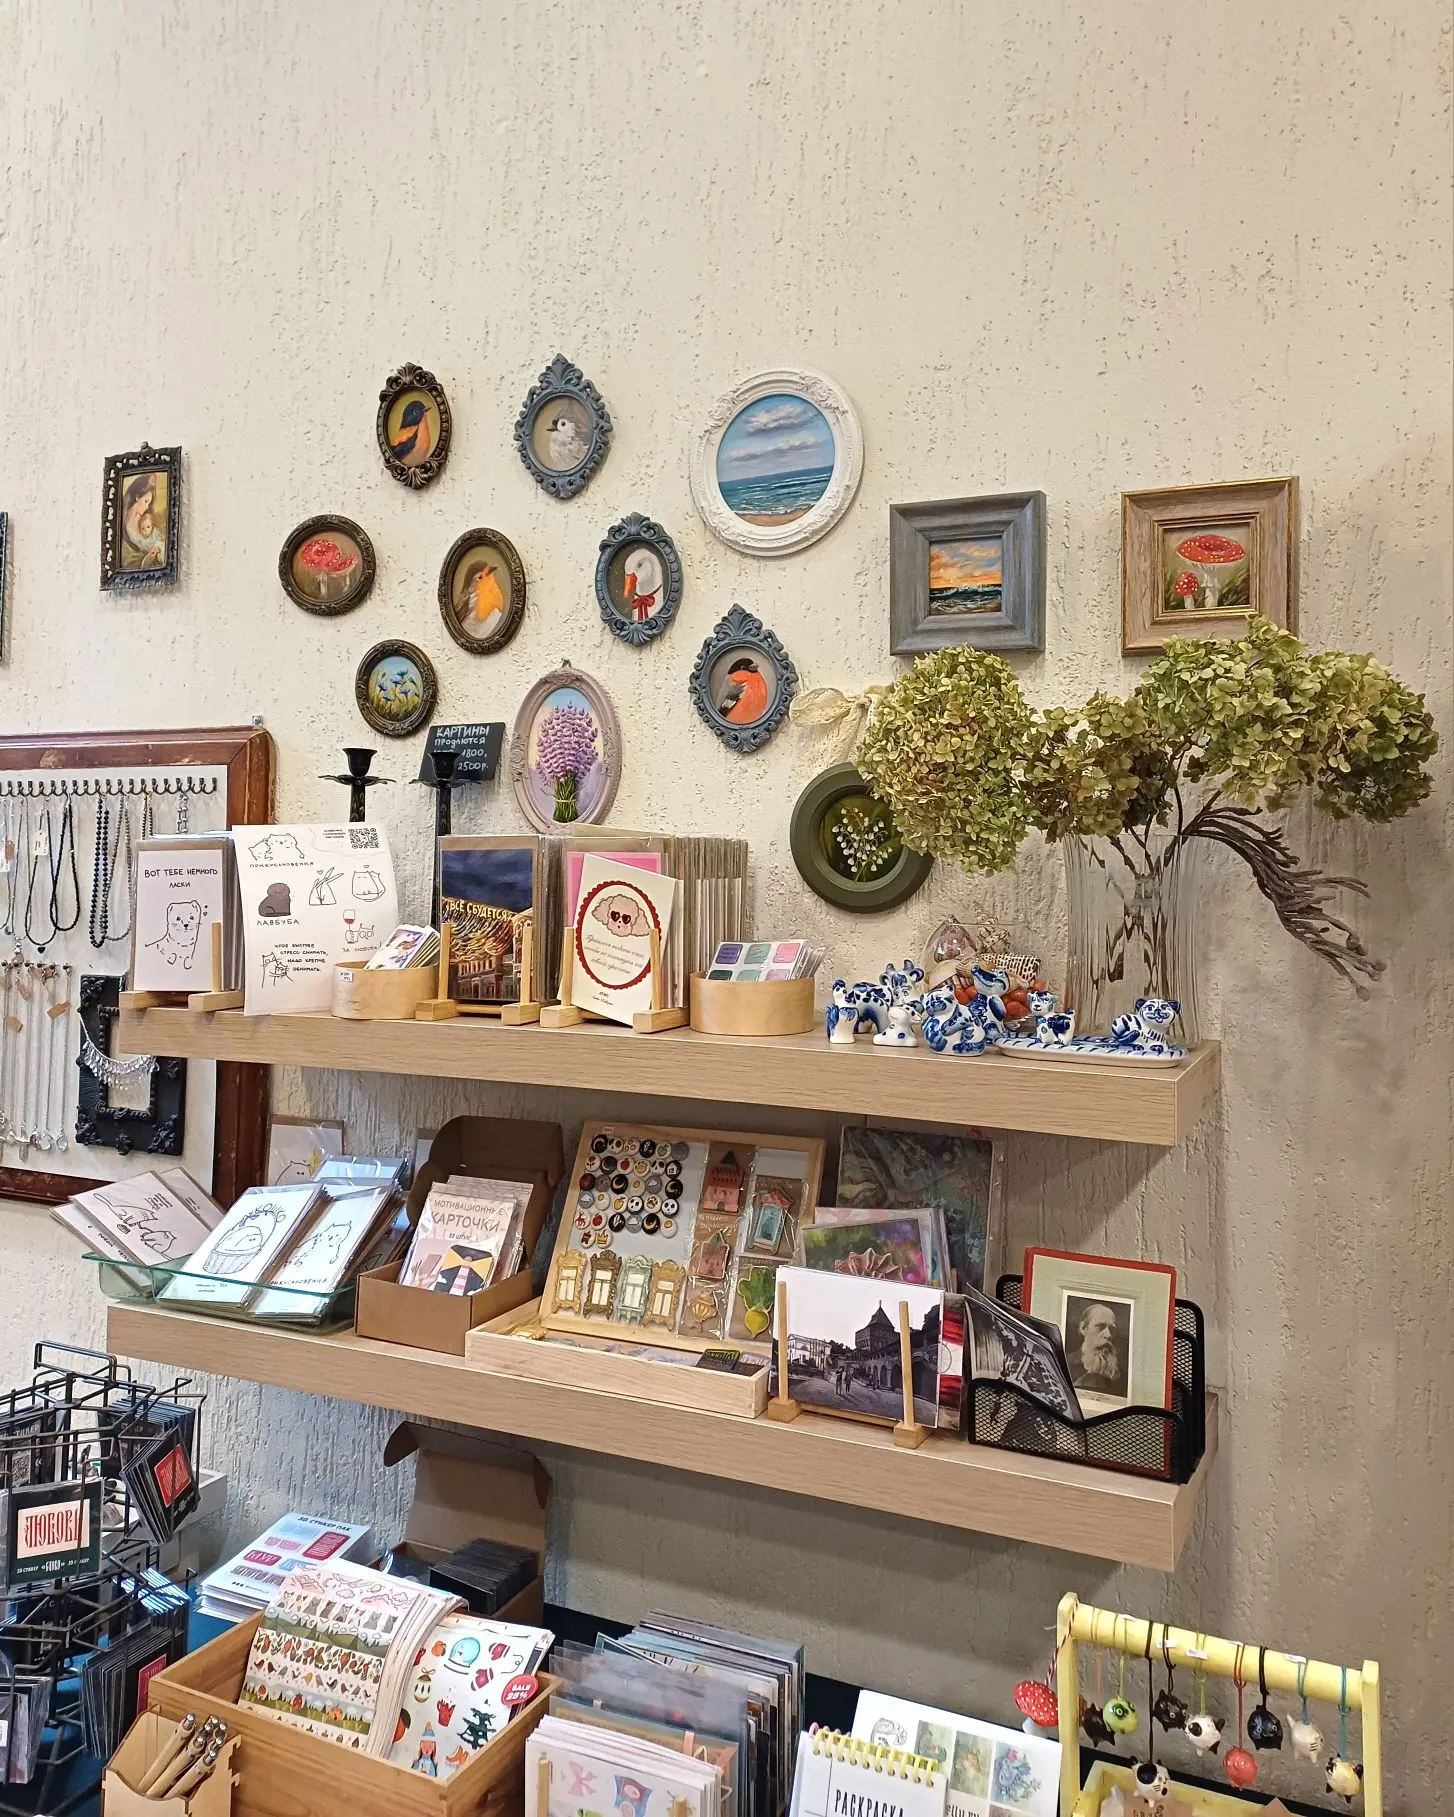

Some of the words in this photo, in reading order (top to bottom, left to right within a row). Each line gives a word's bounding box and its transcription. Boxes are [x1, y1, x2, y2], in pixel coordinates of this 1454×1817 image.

[436, 725, 490, 738] КАРТИНЫ
[461, 748, 487, 758] 1800,
[144, 869, 161, 878] ВОТ
[163, 868, 183, 876] ТЕБЕ
[187, 868, 218, 876] НЕМНОГО
[466, 902, 507, 921] СБУДЕТСЯ
[256, 918, 300, 926] ЛАВБУБА
[431, 1211, 500, 1232] КАРТОЧКИ
[13, 1424, 41, 1437] ТИКЕР
[309, 1519, 337, 1528] СТИКЕР
[23, 1565, 39, 1573] СТИКЕР
